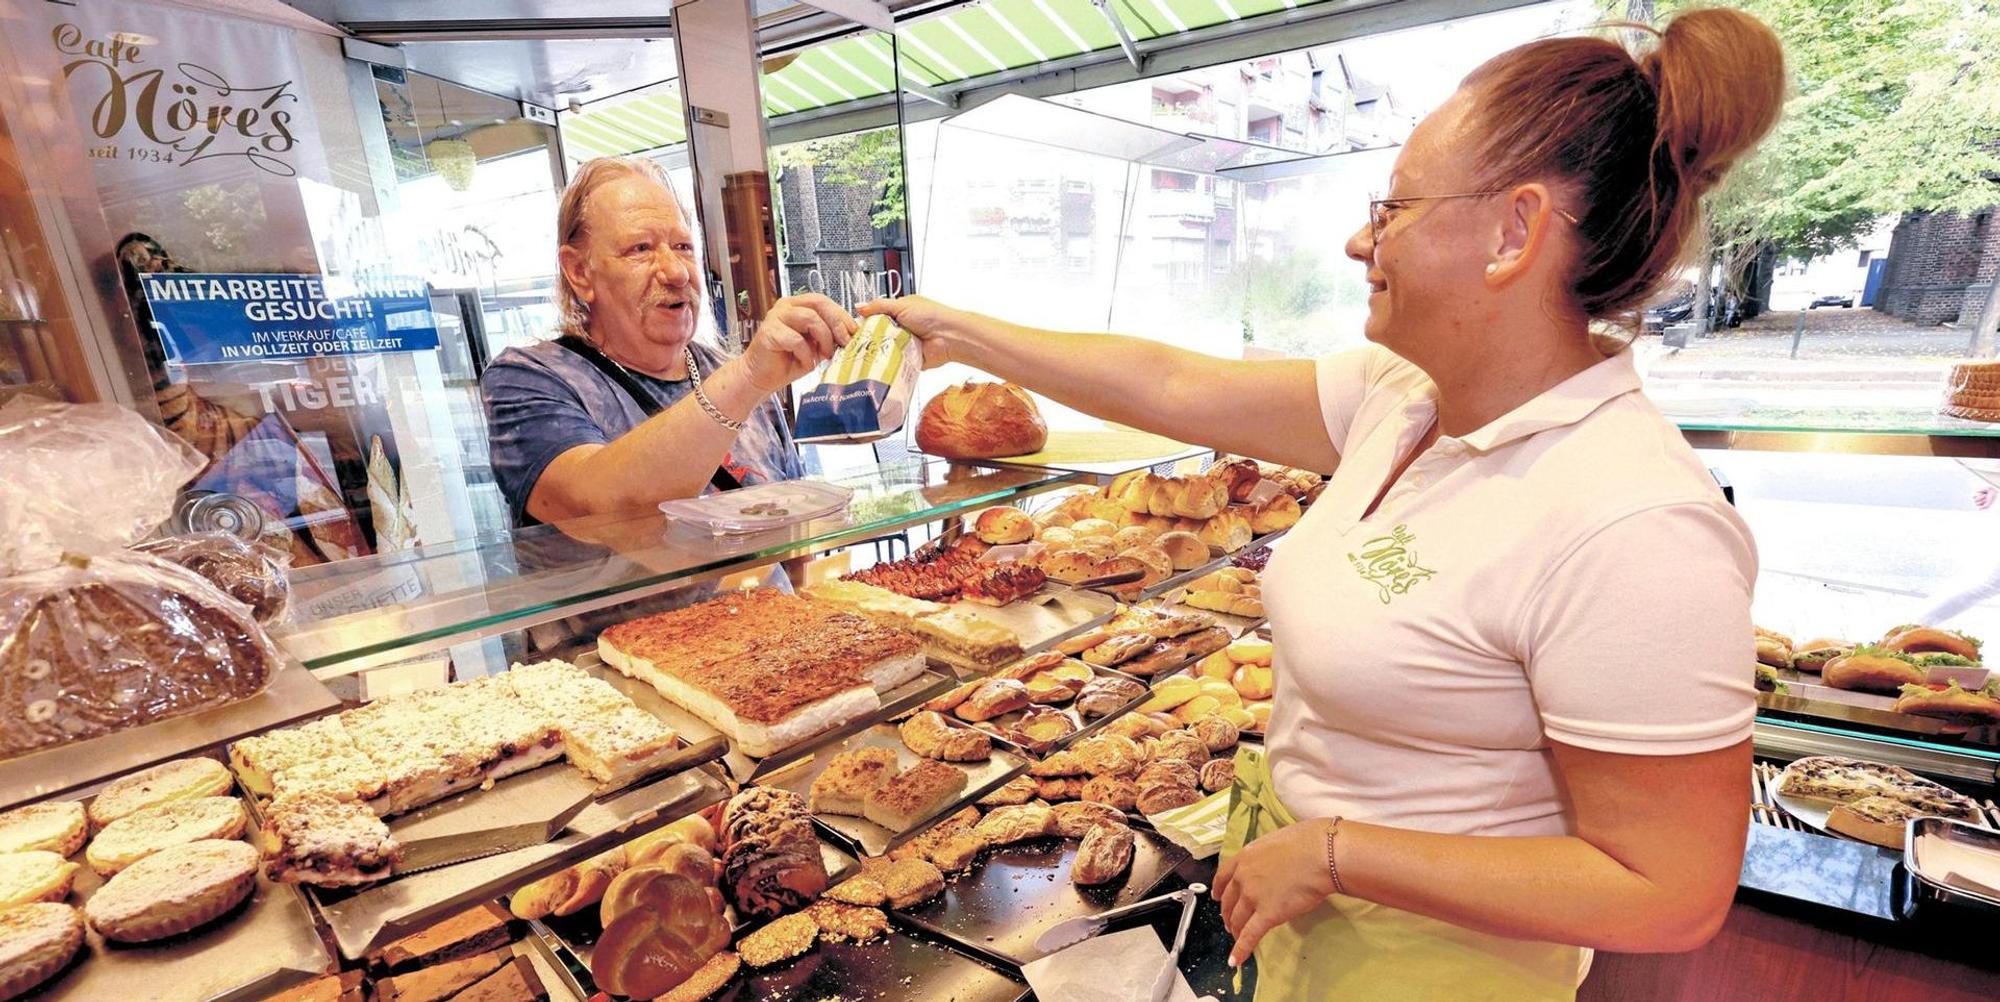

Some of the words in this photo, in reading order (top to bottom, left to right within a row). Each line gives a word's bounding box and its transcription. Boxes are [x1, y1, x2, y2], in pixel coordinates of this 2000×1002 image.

[52, 22, 145, 67] Café
[89, 145, 118, 160] seit
[127, 147, 174, 164] 1934
[244, 299, 375, 321] GESUCHT!
[252, 329, 269, 343] IM
[221, 345, 238, 358] IN
[240, 341, 309, 358] VOLLZEIT
[311, 339, 351, 352] ODER
[350, 338, 403, 350] TEILZEIT
[248, 374, 379, 414] TIGER
